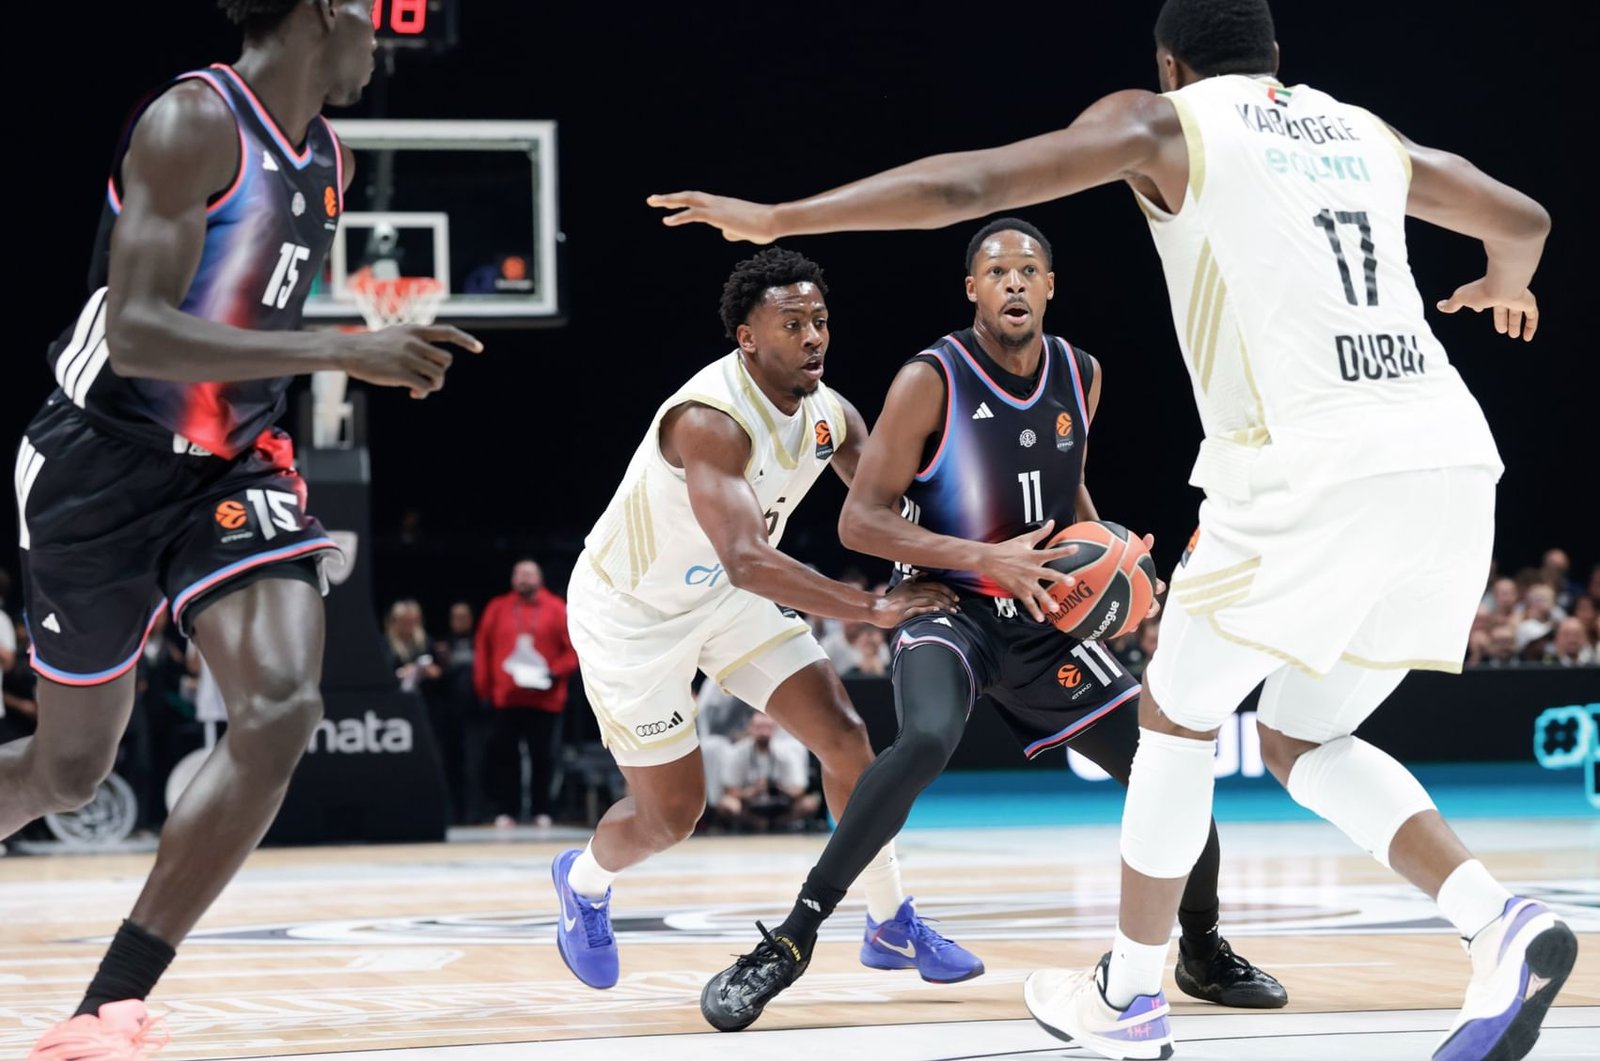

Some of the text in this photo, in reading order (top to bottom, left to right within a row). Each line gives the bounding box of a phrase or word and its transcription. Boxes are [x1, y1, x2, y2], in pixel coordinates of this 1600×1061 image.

[261, 241, 311, 310] 15
[1312, 208, 1379, 307] 17
[1334, 333, 1426, 382] DUBAI
[245, 488, 303, 541] 15
[1017, 470, 1044, 524] 11
[1070, 640, 1124, 688] 11
